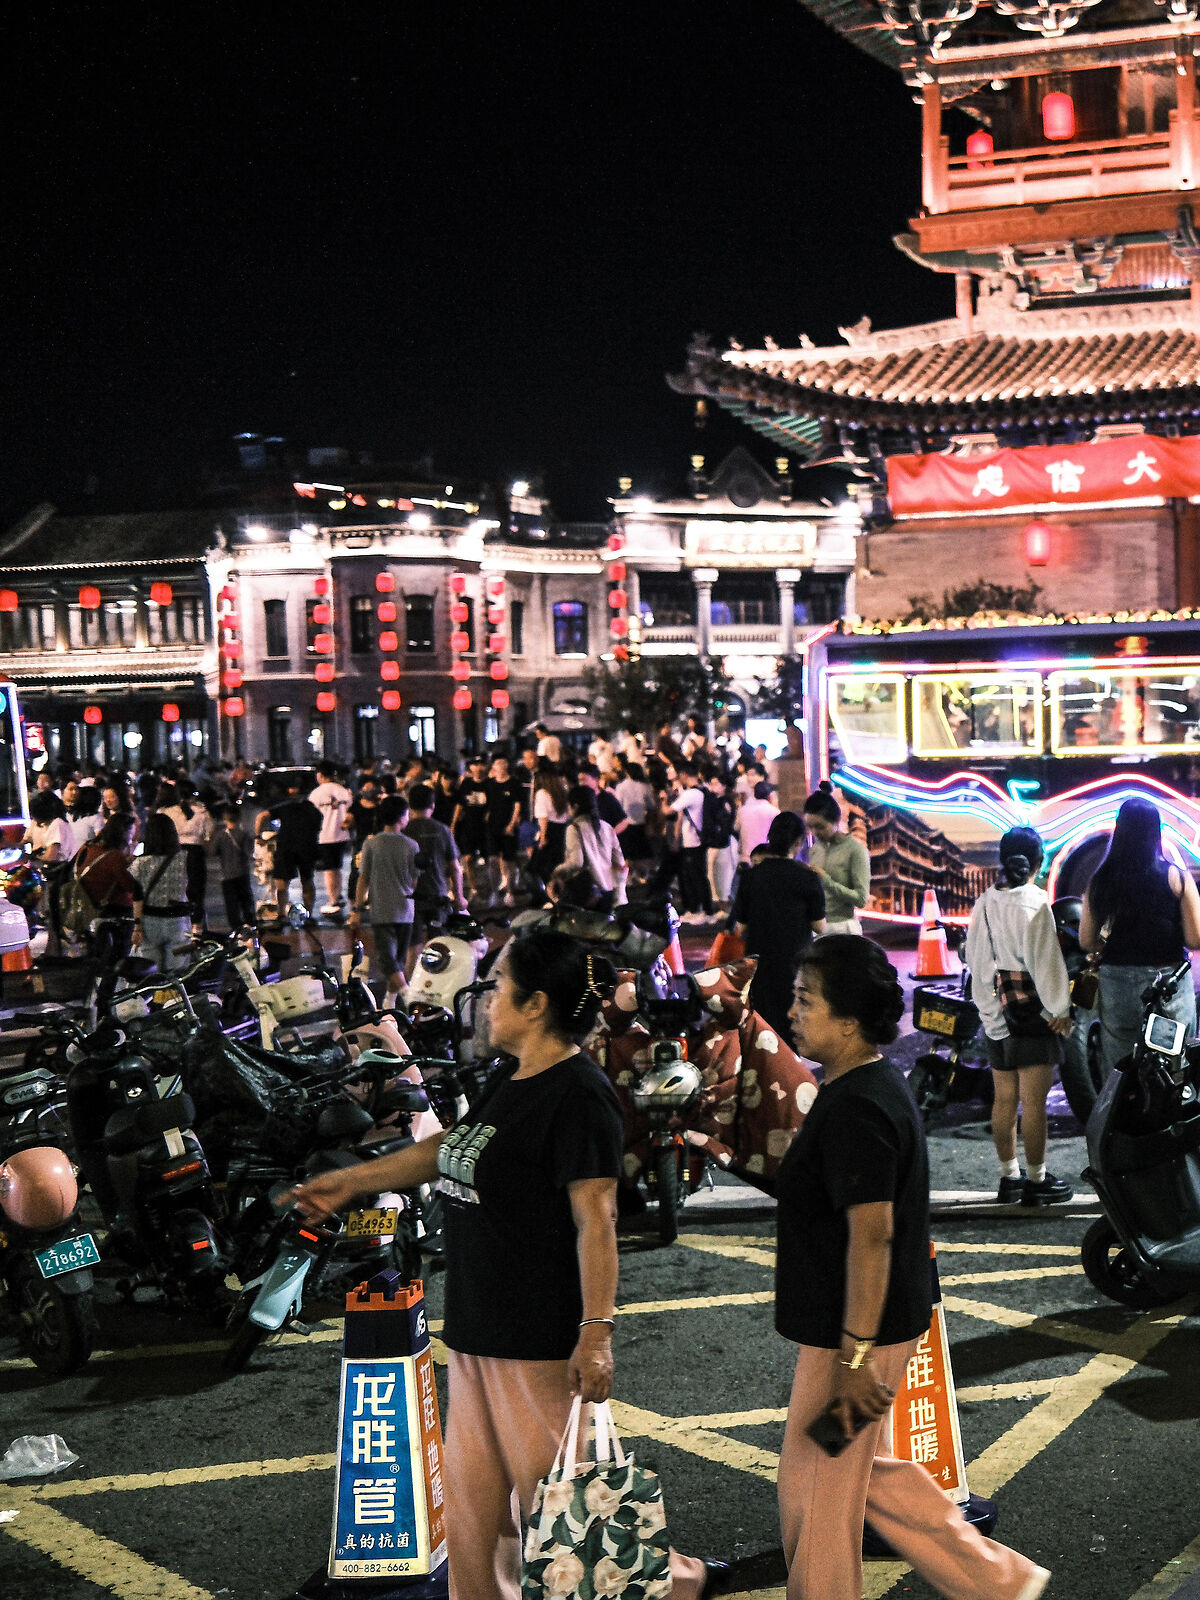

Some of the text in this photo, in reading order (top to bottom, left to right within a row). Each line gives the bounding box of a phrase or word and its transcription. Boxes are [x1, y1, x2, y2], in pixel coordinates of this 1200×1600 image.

[43, 1246, 94, 1270] 278692
[343, 1532, 410, 1550] 真的抗菌
[342, 1562, 410, 1573] 400-882-6662
